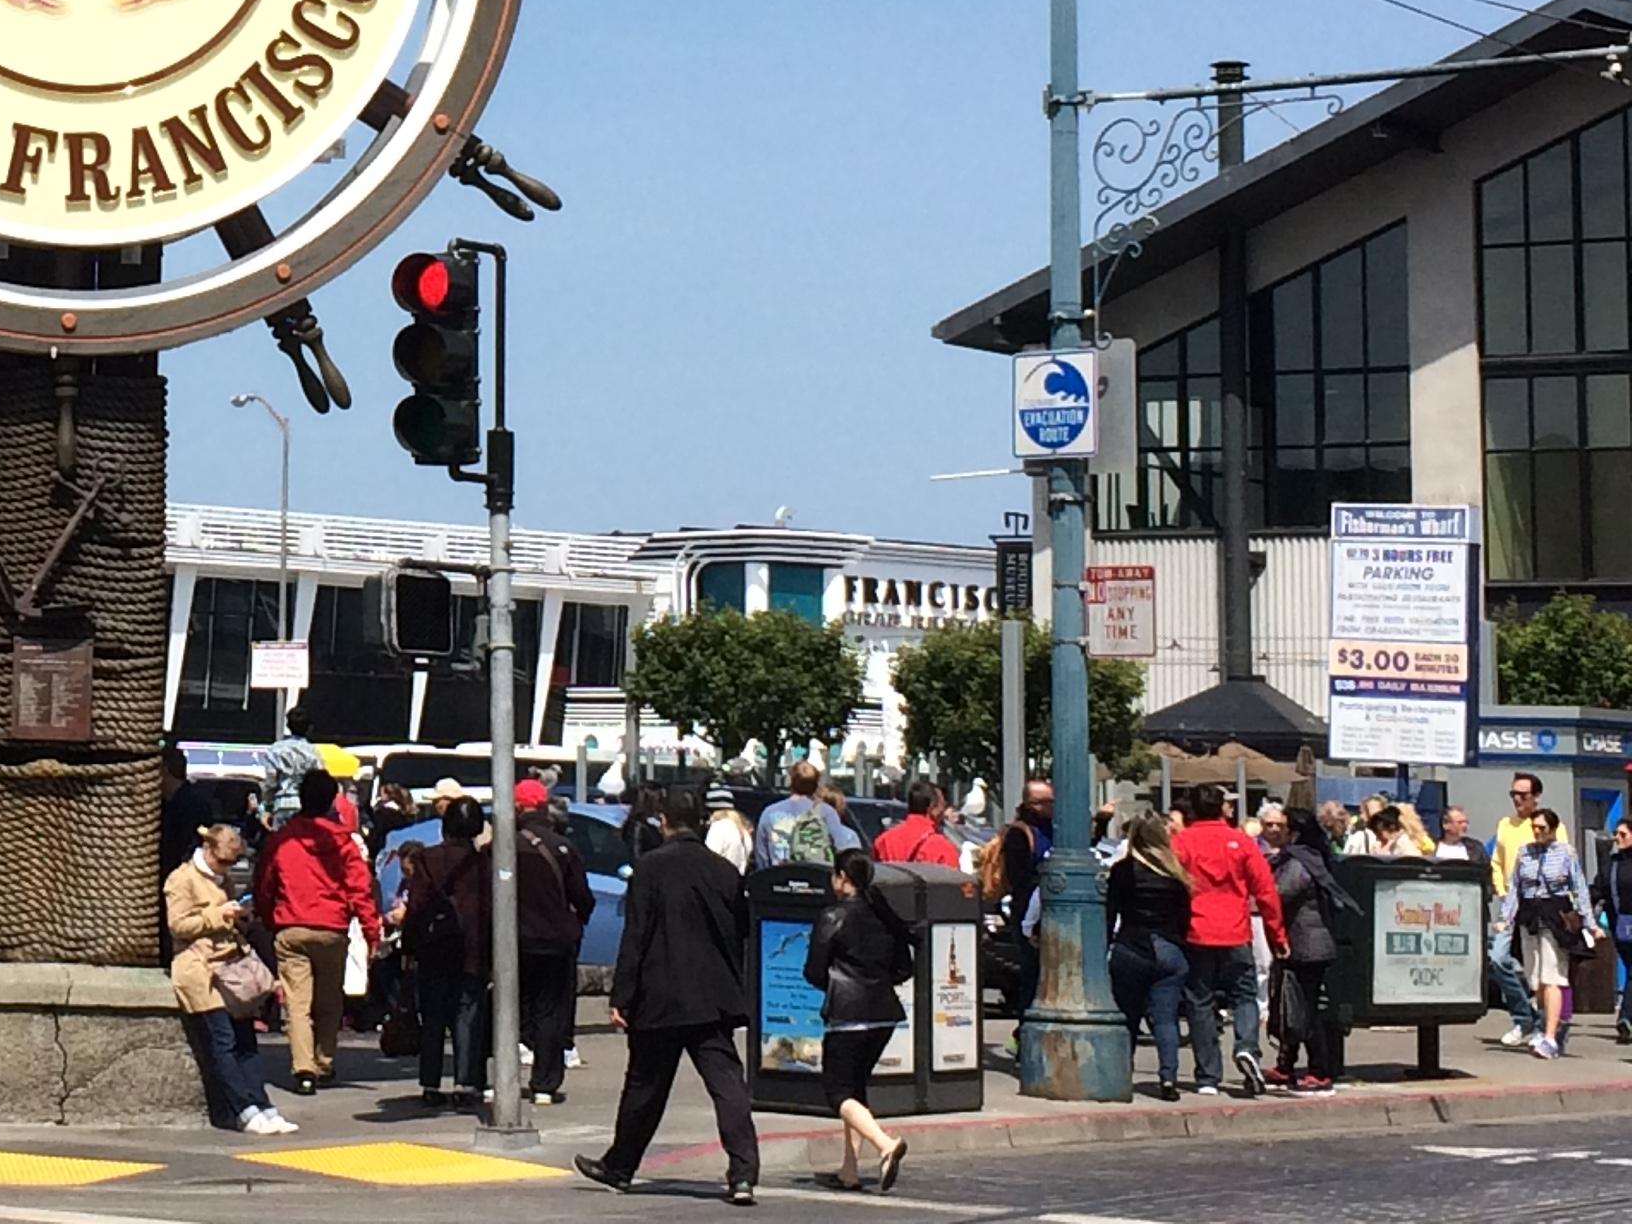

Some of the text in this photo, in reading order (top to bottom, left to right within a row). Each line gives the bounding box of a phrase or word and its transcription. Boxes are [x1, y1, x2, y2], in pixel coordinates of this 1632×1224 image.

[1023, 409, 1084, 427] EVACUATION
[1039, 426, 1070, 443] ROUTE
[1341, 510, 1462, 535] Fisherman's Wharf
[1382, 549, 1423, 563] HOURS
[1426, 550, 1454, 564] FREE
[1363, 566, 1434, 580] PARKING
[844, 574, 999, 612] FRANCISC
[1108, 606, 1135, 621] ANY
[1104, 625, 1138, 640] TIME
[1337, 647, 1410, 672] $3.00
[1582, 732, 1623, 753] CHASE
